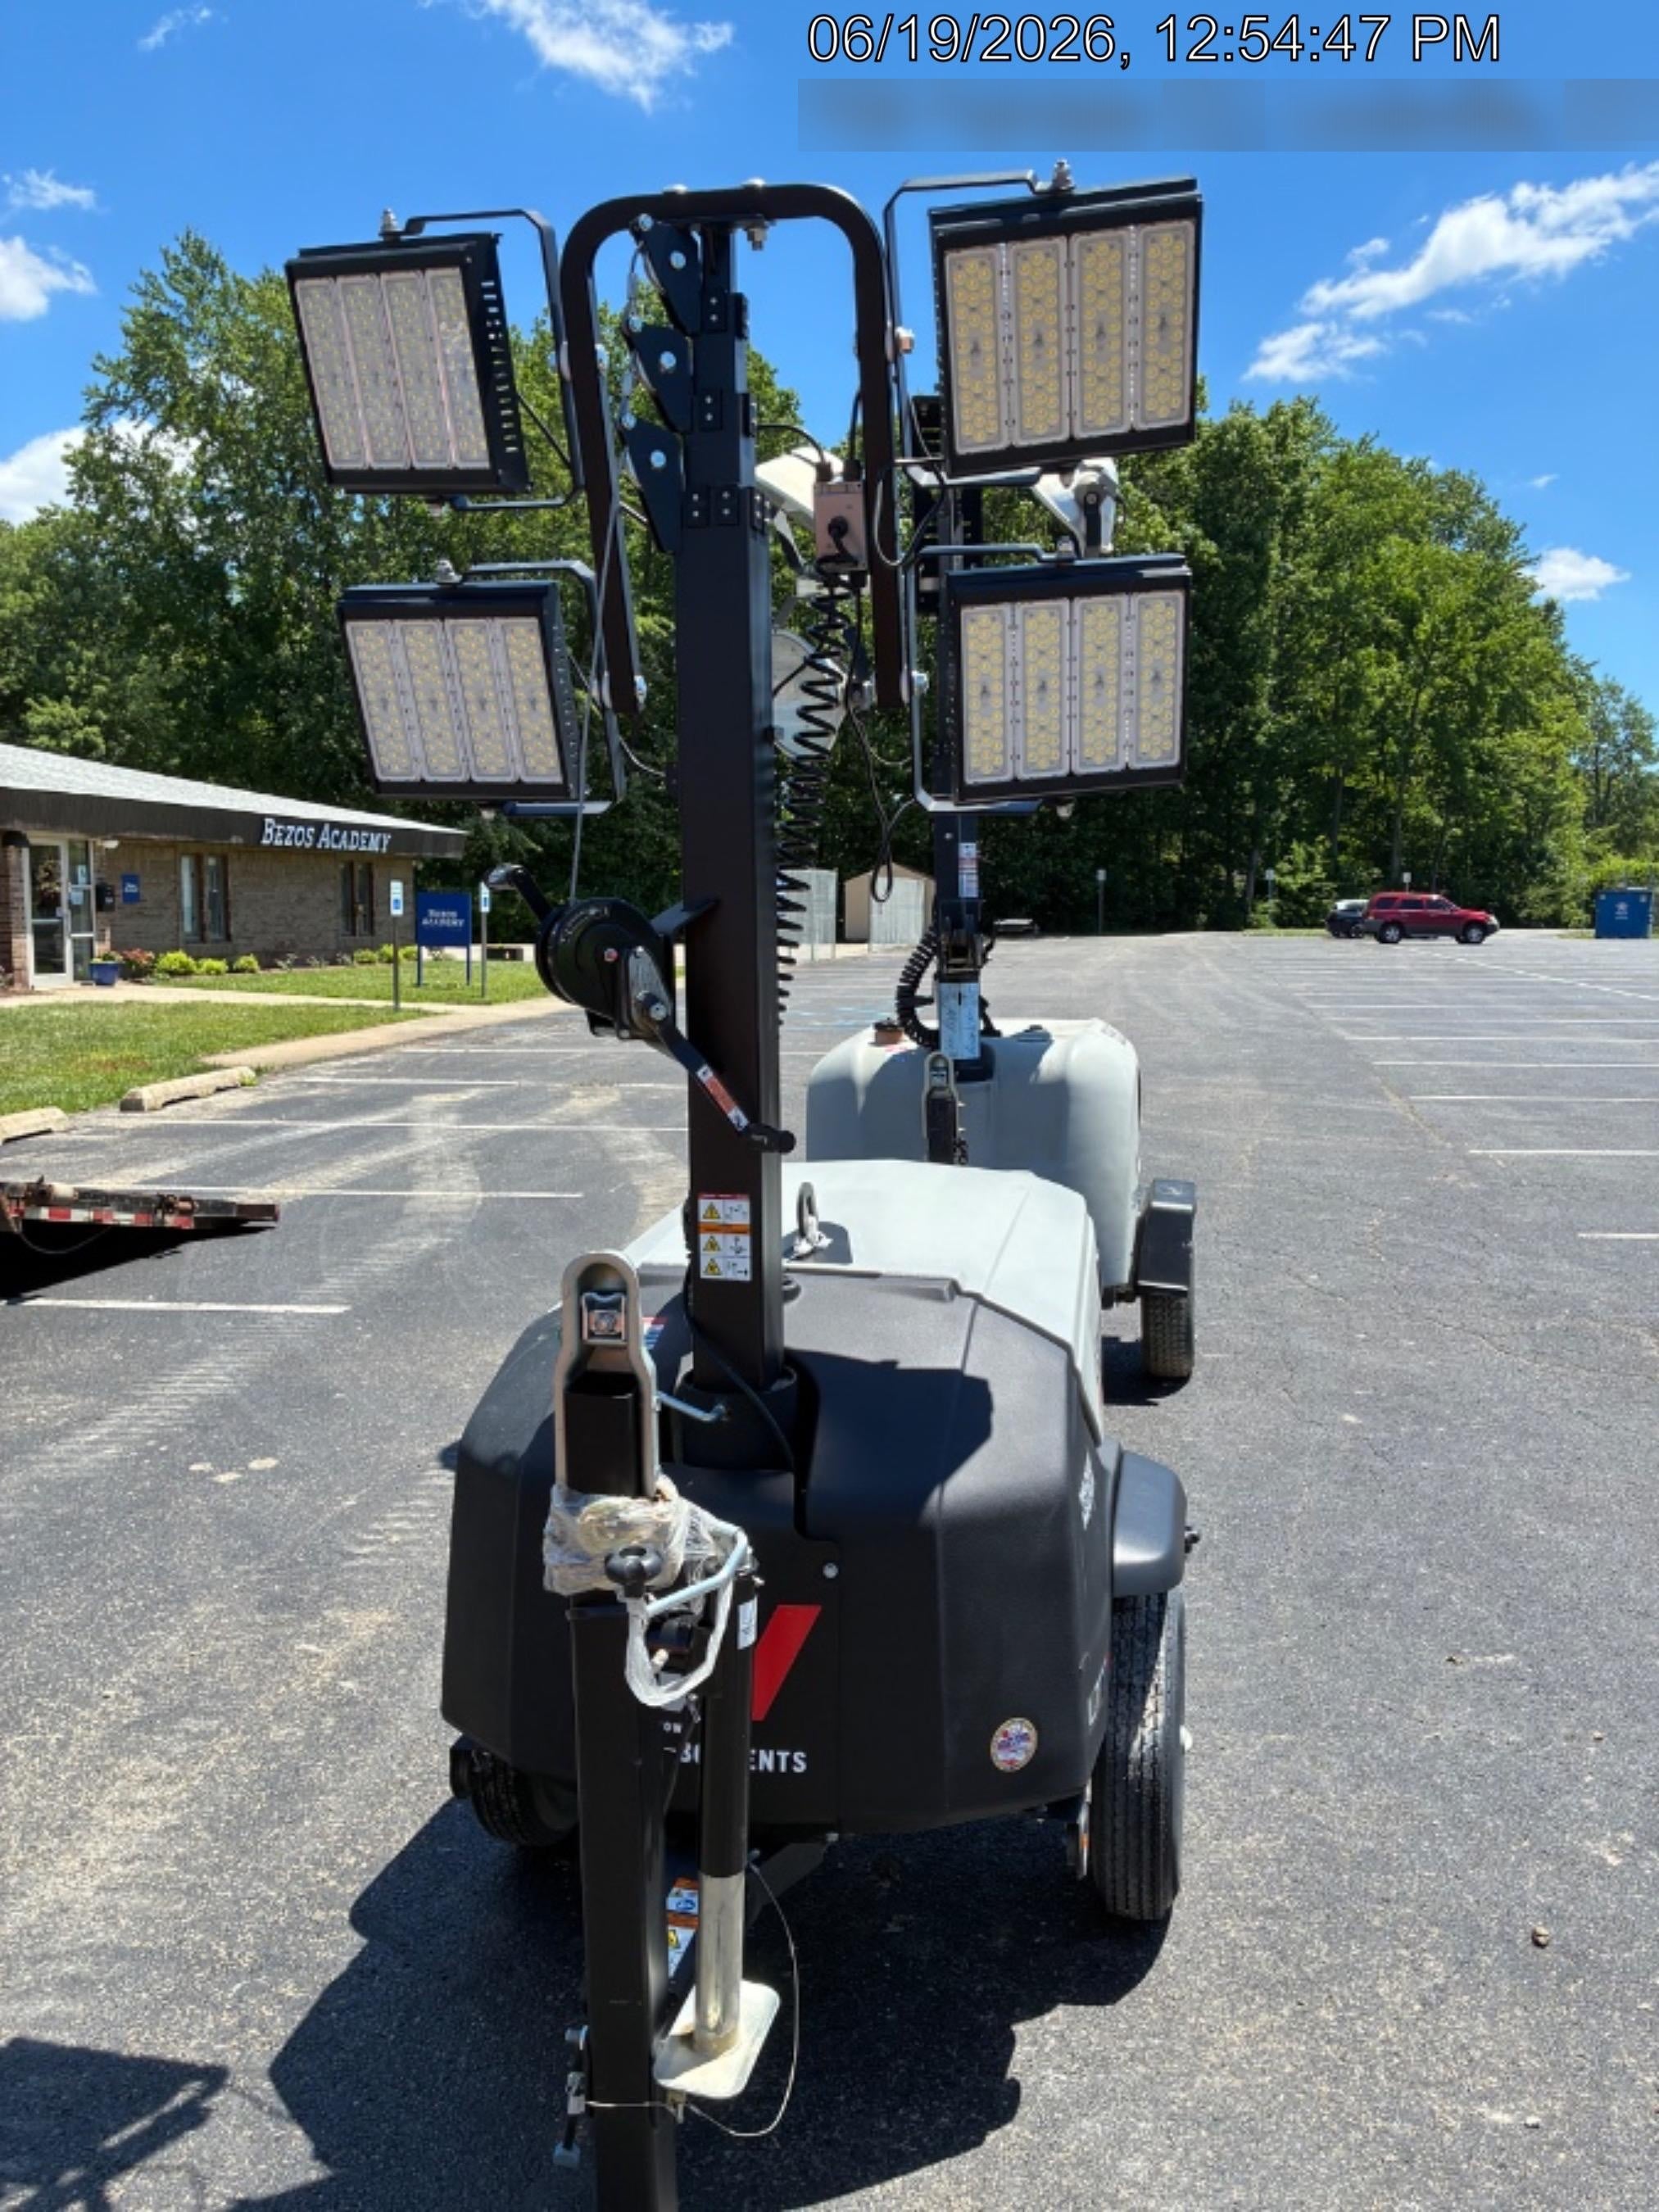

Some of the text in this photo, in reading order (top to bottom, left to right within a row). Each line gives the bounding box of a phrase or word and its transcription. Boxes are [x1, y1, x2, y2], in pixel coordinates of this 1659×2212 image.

[261, 818, 392, 853] BEZOS ACADEMY
[749, 1748, 807, 1773] ENTS
